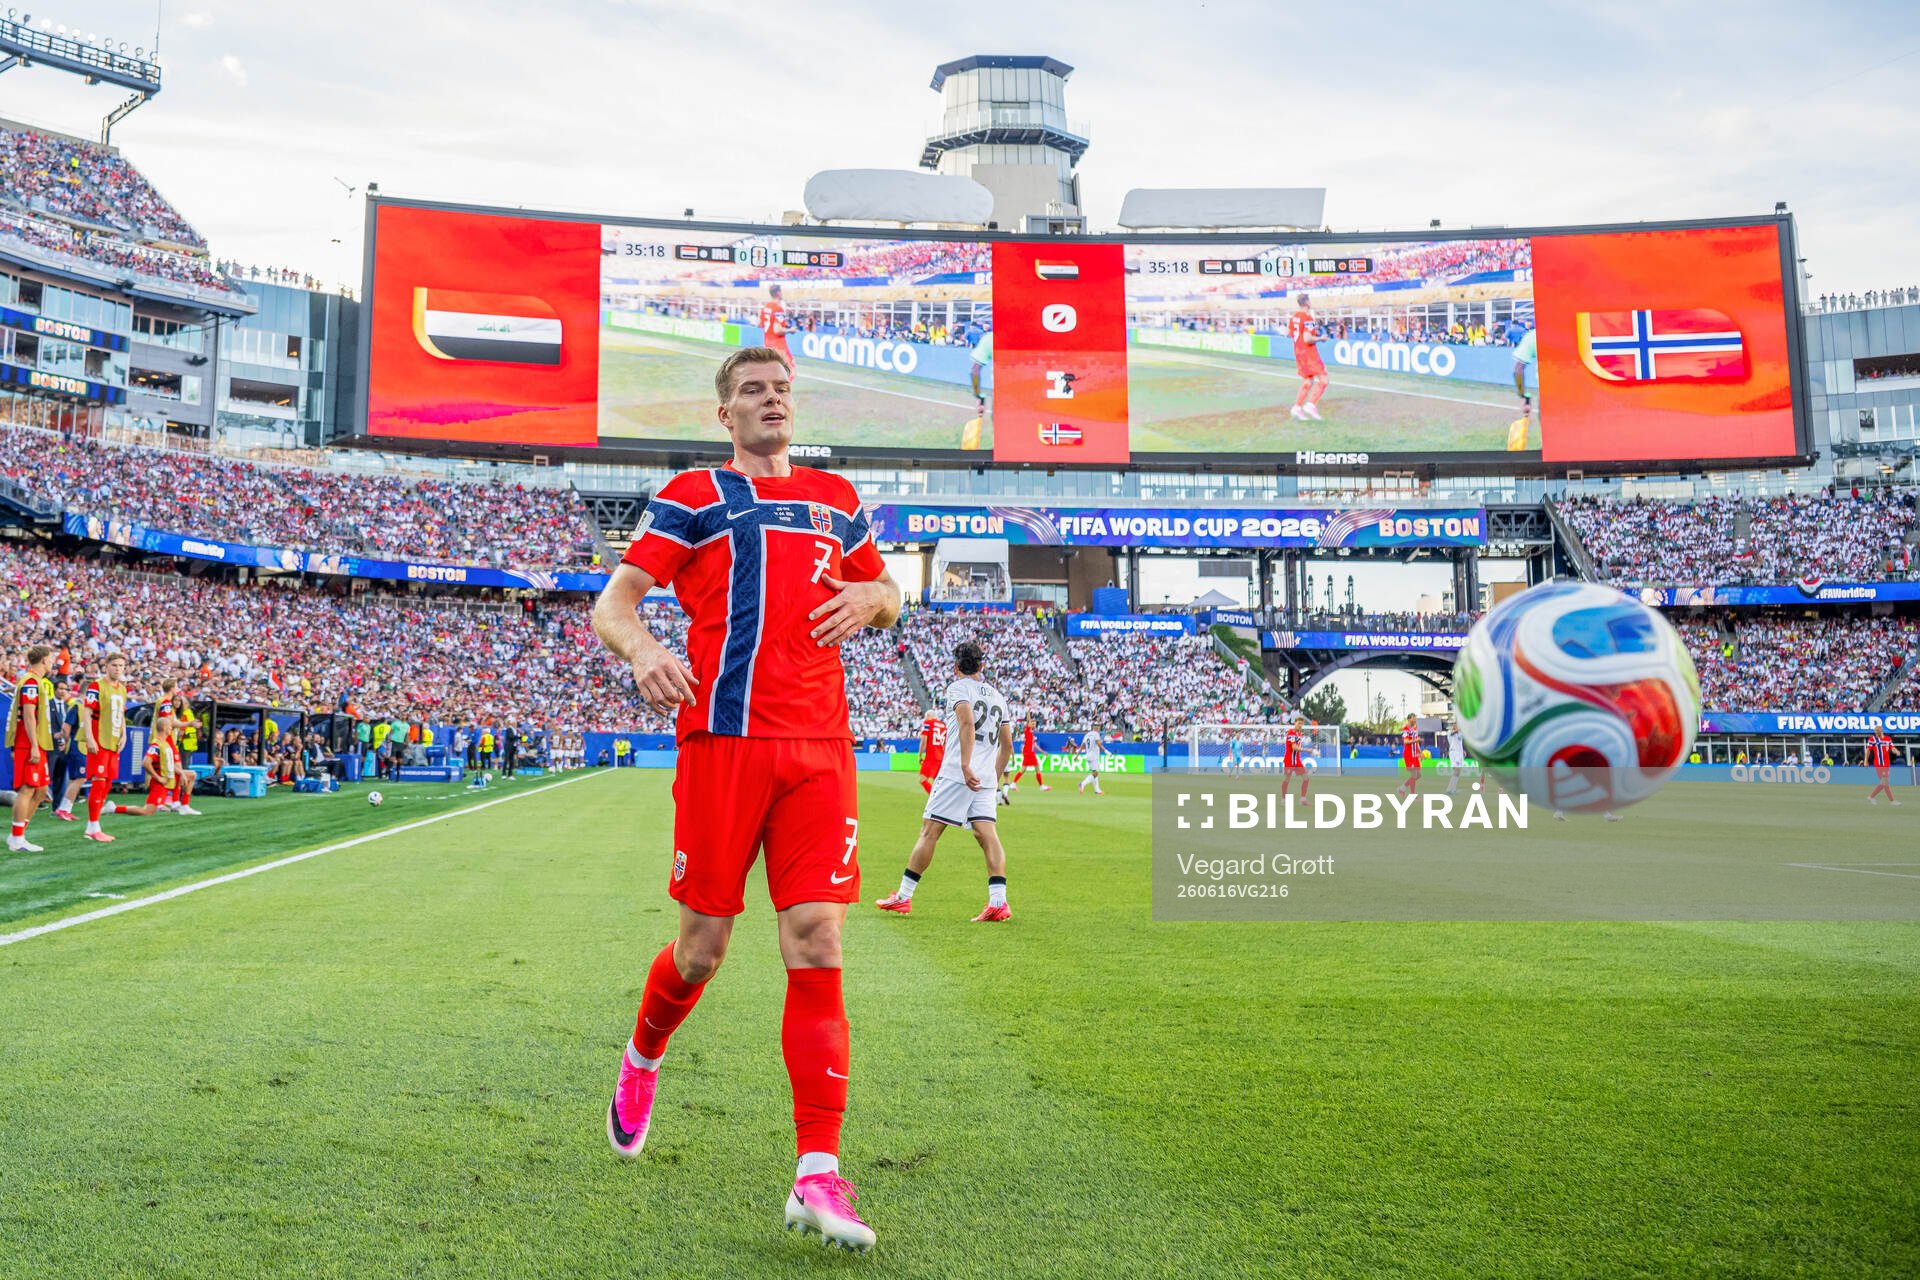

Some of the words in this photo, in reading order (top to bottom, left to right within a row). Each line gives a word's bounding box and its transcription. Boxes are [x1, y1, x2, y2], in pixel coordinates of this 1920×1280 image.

[625, 243, 665, 258] 35:18
[739, 251, 747, 262] 0
[772, 252, 778, 263] 1
[786, 250, 808, 264] NOR
[1149, 261, 1189, 274] 35:18
[1236, 260, 1255, 273] IRQ
[1265, 262, 1273, 273] 0
[1298, 262, 1304, 273] 1
[1314, 259, 1336, 272] NOR
[35, 317, 91, 342] BOSTON
[802, 332, 918, 370] aramco
[1334, 340, 1456, 376] aramco
[30, 371, 87, 395] BOSTON
[787, 445, 832, 457] ense
[1295, 450, 1369, 465] Hisense
[908, 514, 1004, 534] BOSTON
[1059, 516, 1107, 536] FIFA
[1109, 517, 1190, 537] WORLD
[1193, 518, 1239, 537] CUP
[1241, 518, 1321, 537] 2026
[1379, 518, 1480, 537] BOSTON
[810, 540, 833, 584] 7
[407, 565, 466, 581] BOSTON
[1080, 620, 1100, 630] FIFA
[1099, 620, 1132, 630] WORLD
[1132, 620, 1150, 630] CUP
[1216, 613, 1253, 625] BOSTON
[1344, 635, 1369, 646] FIFA
[1370, 635, 1409, 646] WORLD
[1410, 636, 1432, 647] CUP
[973, 700, 1003, 746] 23
[1777, 716, 1816, 730] FIFA
[1817, 716, 1883, 730] WORLD
[1884, 716, 1920, 730] CUP
[1730, 764, 1831, 784] aramco
[842, 816, 858, 866] 7
